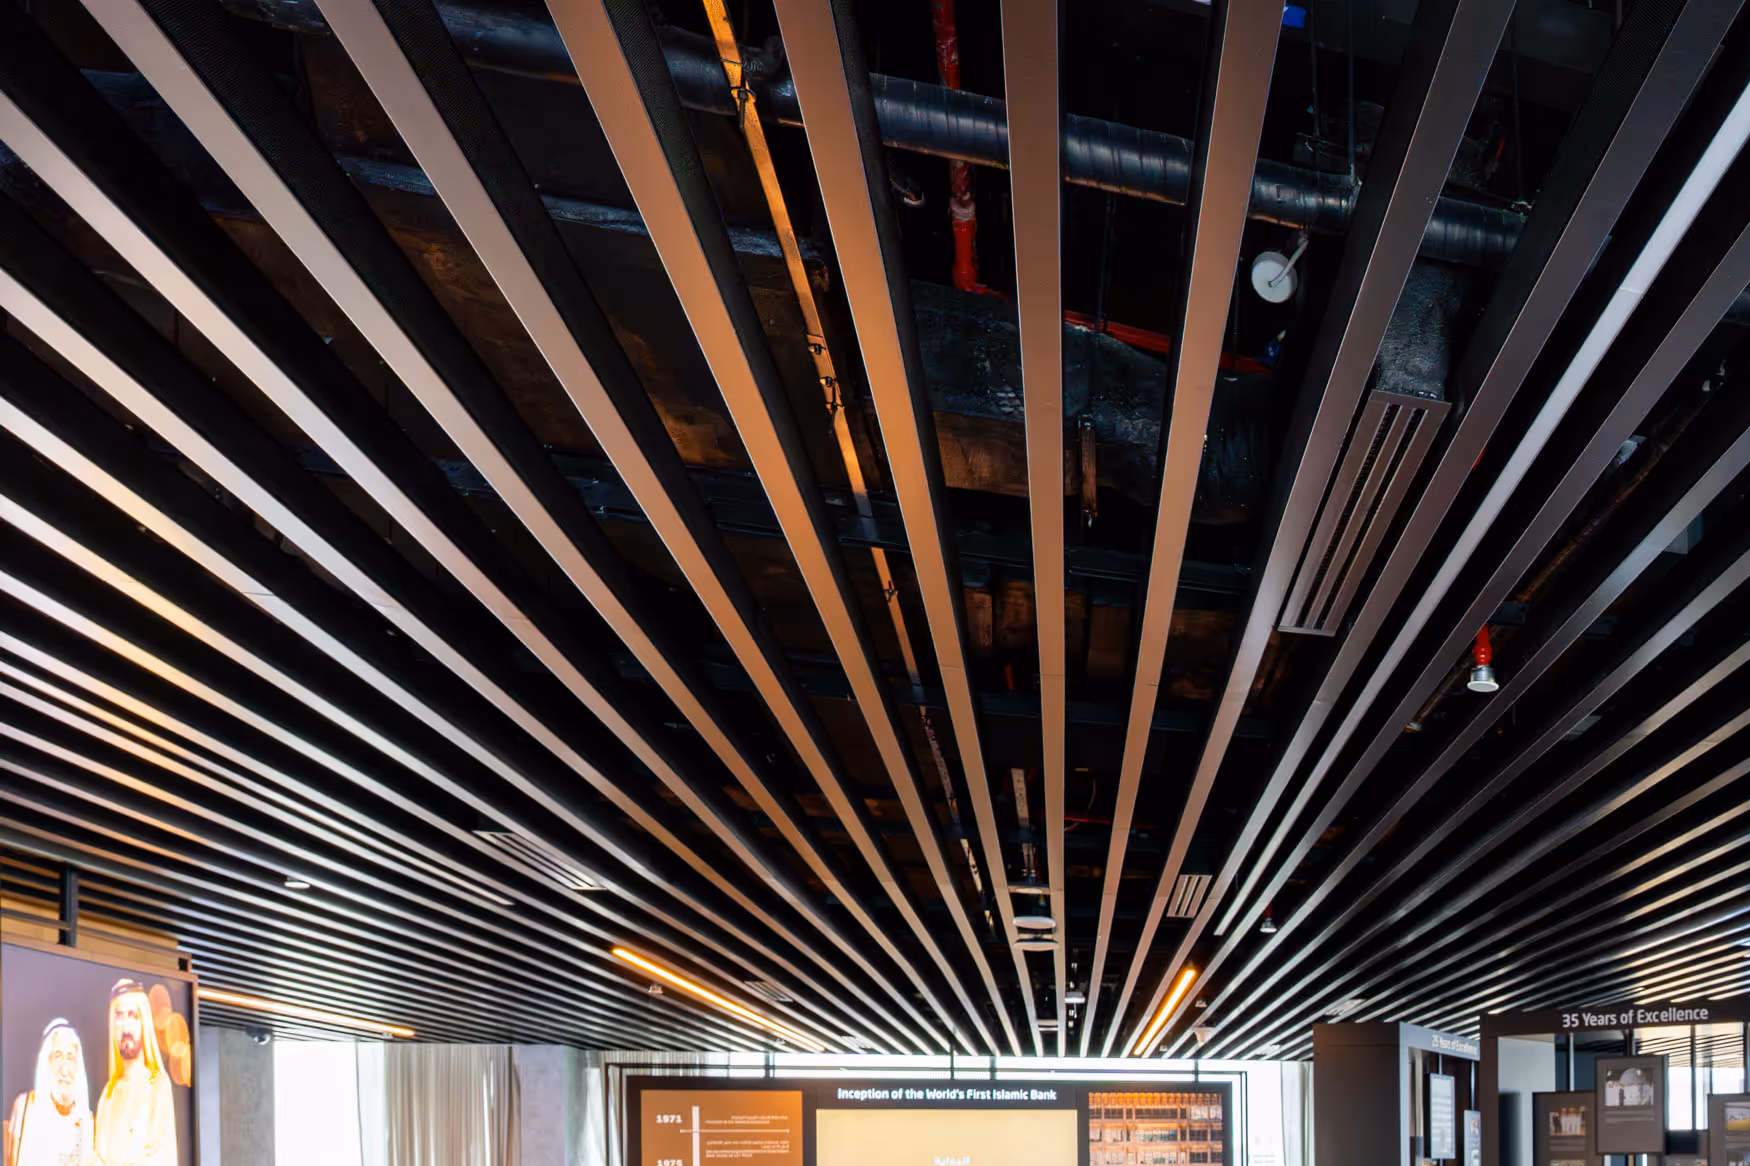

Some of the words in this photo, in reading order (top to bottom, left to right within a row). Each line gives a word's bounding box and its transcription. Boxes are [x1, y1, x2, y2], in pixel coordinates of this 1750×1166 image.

[1562, 1014, 1579, 1028] 35
[1582, 1012, 1616, 1026] Years
[1620, 1010, 1634, 1024] of
[1637, 1008, 1708, 1023] Excellence
[837, 1088, 890, 1101] Inception
[891, 1088, 904, 1099] of
[905, 1088, 924, 1099] the
[926, 1089, 964, 1100] World's
[966, 1089, 990, 1100] First
[992, 1089, 1028, 1100] Islamic
[1030, 1089, 1057, 1100] Bank
[656, 1114, 682, 1123] 1971
